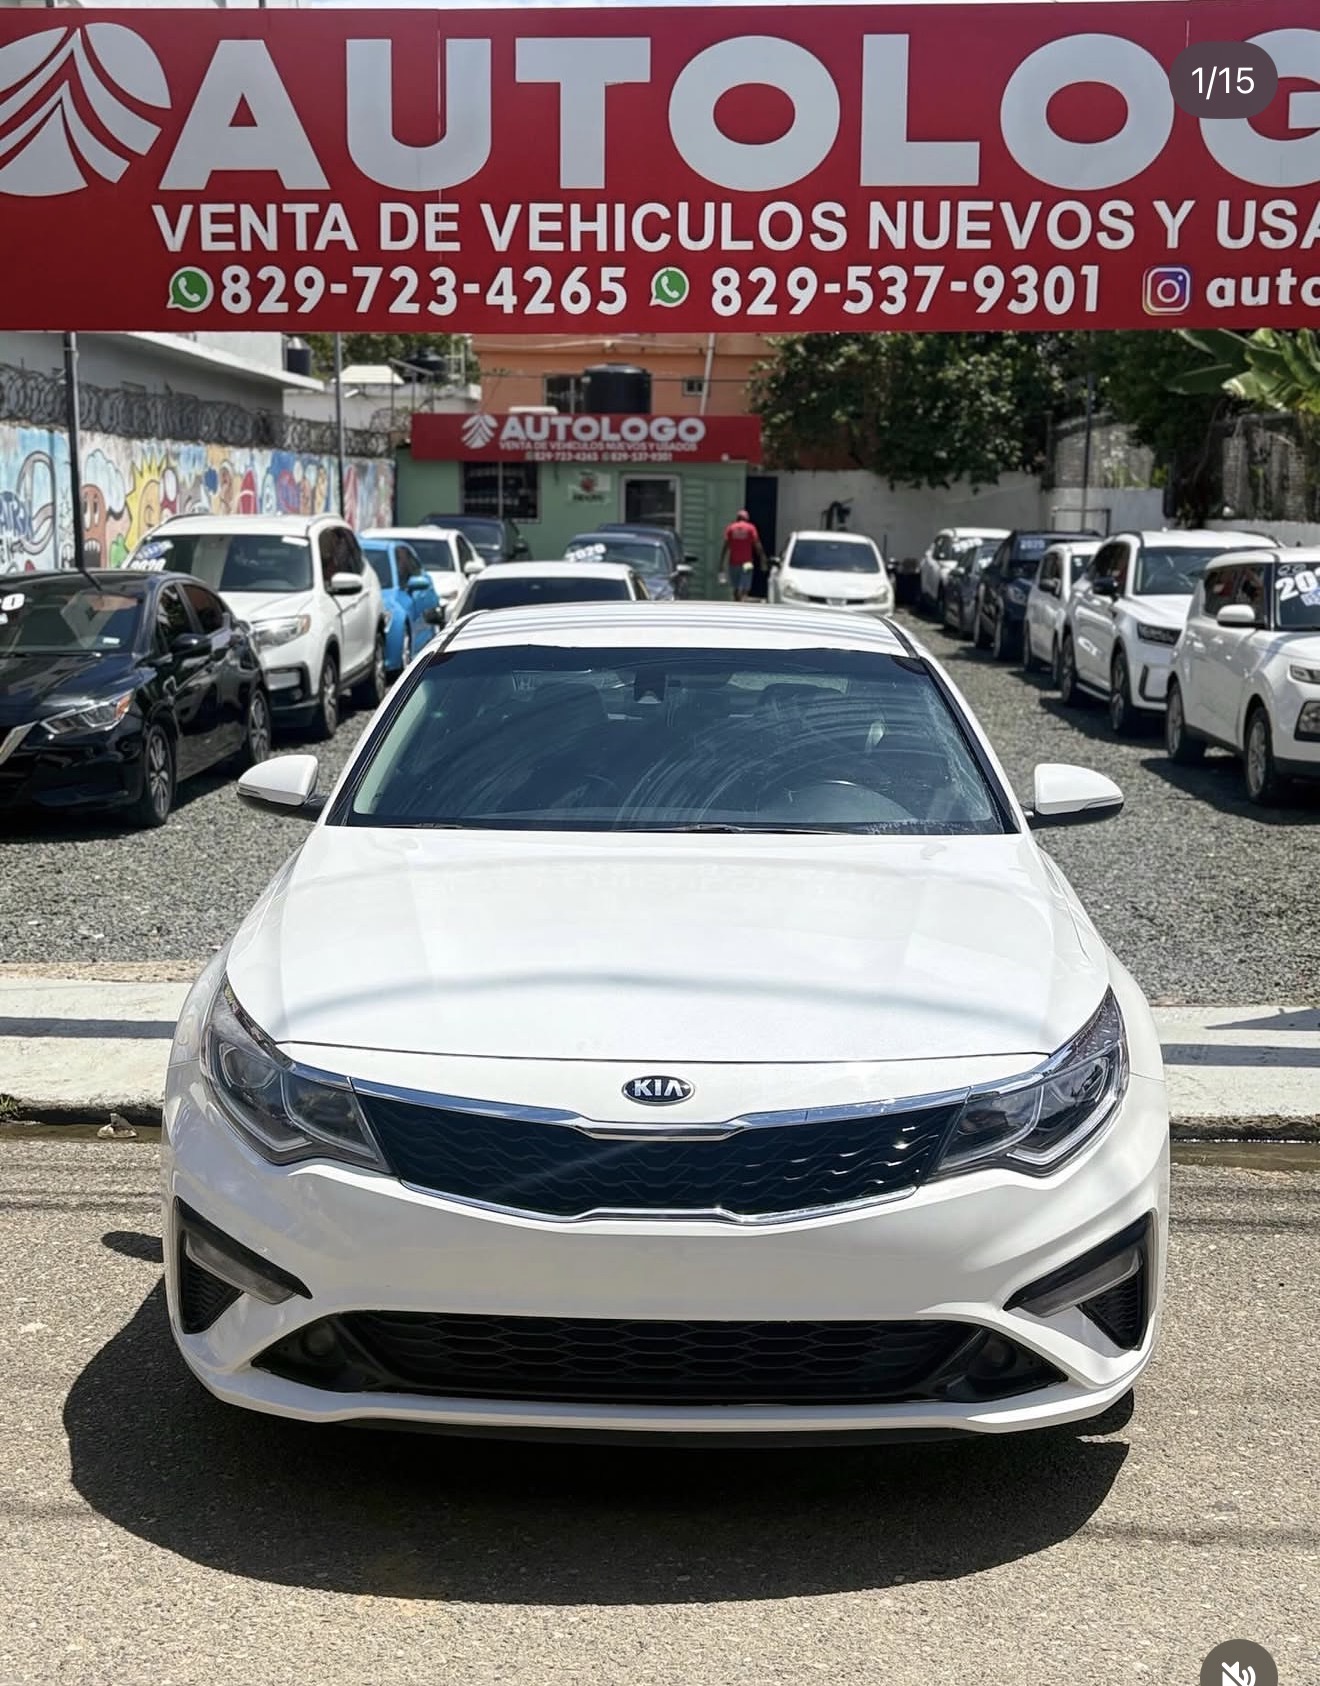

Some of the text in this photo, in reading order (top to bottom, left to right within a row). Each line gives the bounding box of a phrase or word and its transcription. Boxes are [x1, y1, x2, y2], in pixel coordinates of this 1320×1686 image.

[151, 202, 358, 252] VENTA
[380, 202, 461, 252] DE
[480, 201, 848, 253] VEHICULOS
[868, 200, 1135, 250] NUEVOS
[1152, 200, 1196, 249] Y
[221, 265, 627, 316] 829-723-4265
[711, 264, 1099, 317] 829-537-9301
[500, 416, 706, 442] AUTOLOGO
[633, 1079, 684, 1097] KIA
